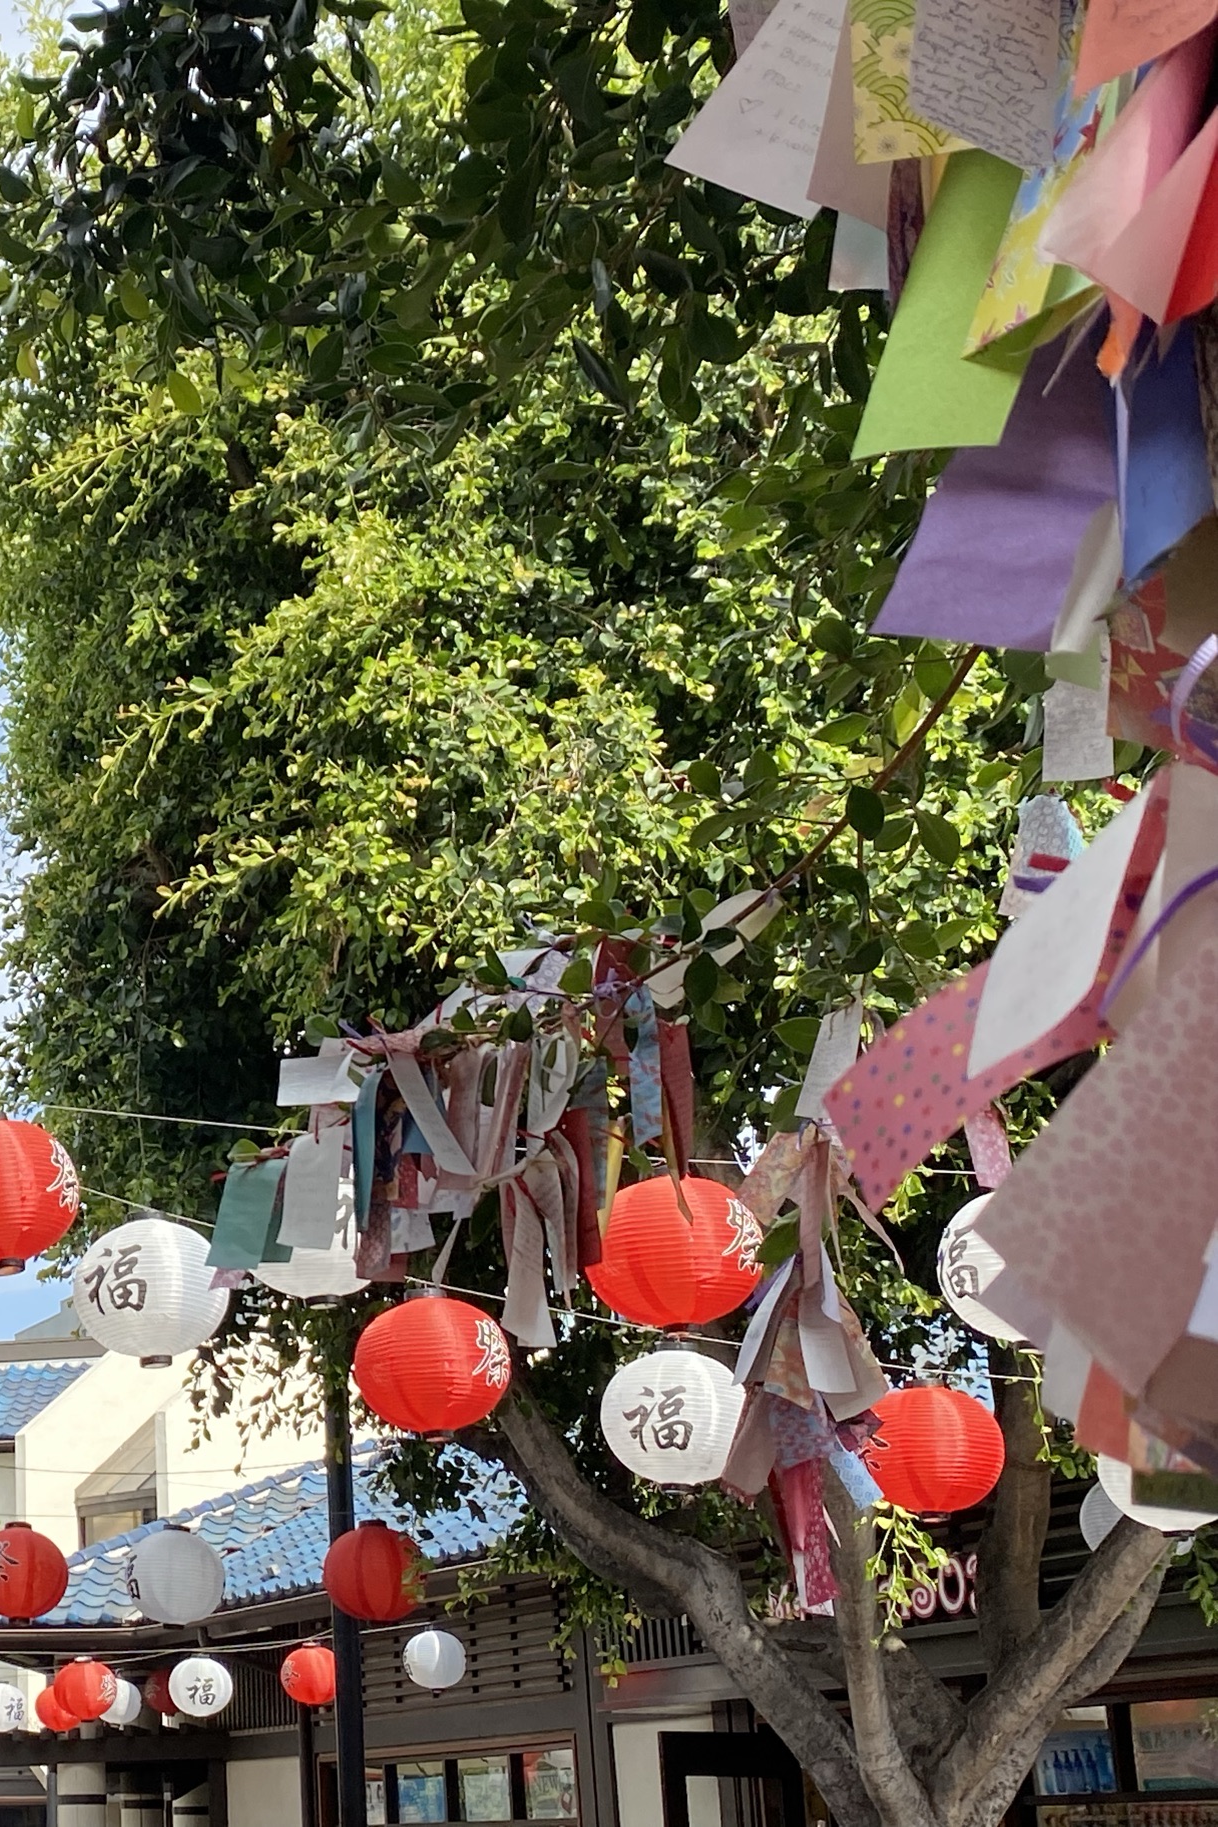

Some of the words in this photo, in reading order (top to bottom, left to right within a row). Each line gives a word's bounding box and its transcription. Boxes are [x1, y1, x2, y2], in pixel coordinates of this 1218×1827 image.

[84, 1244, 148, 1315] 福
[622, 1385, 694, 1453] 福
[4, 1697, 25, 1722] 福
[186, 1676, 216, 1706] 福
